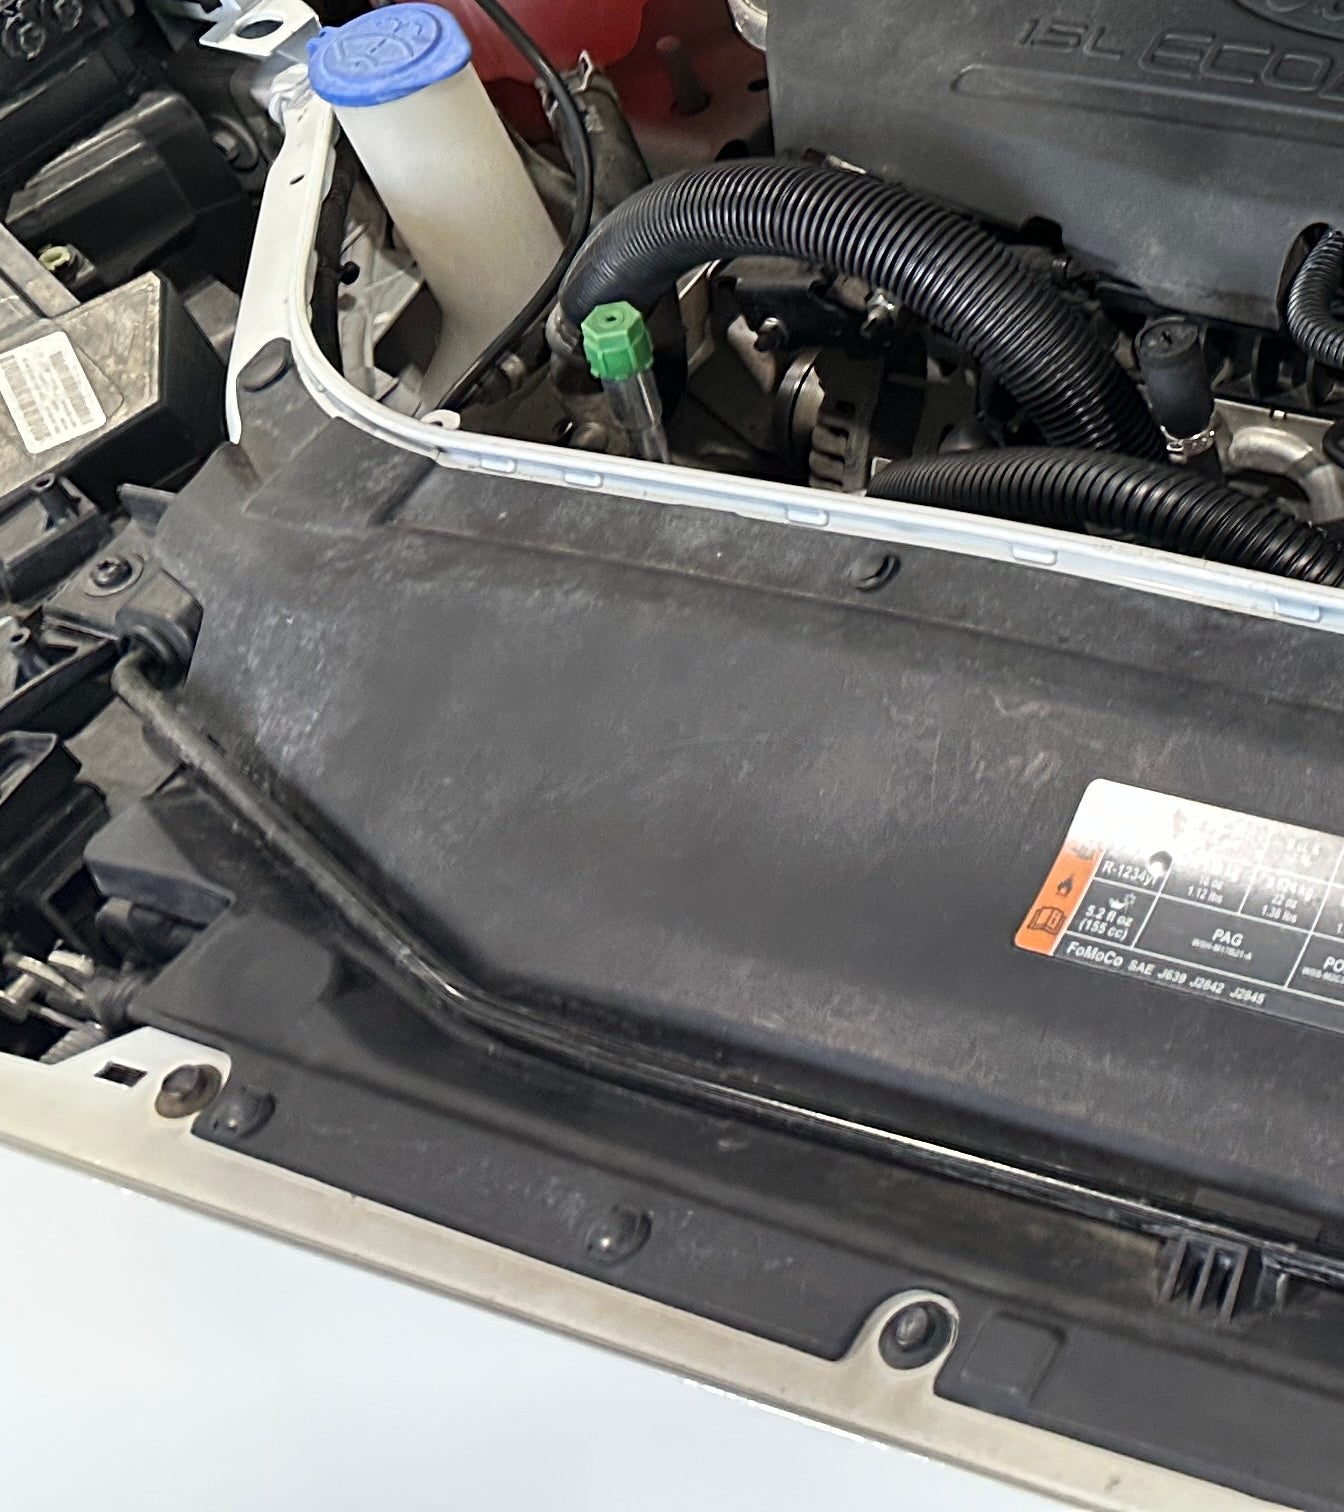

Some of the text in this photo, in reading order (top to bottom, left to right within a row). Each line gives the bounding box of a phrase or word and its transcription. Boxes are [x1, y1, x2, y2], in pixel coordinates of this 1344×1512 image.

[1015, 16, 1122, 62] 1.5L
[1117, 915, 1134, 928] oz
[1107, 926, 1129, 942] cc)
[1212, 928, 1244, 947] PAG
[1066, 941, 1124, 967] FoMoCo
[1127, 959, 1155, 976] SAE
[1157, 968, 1187, 984] J639
